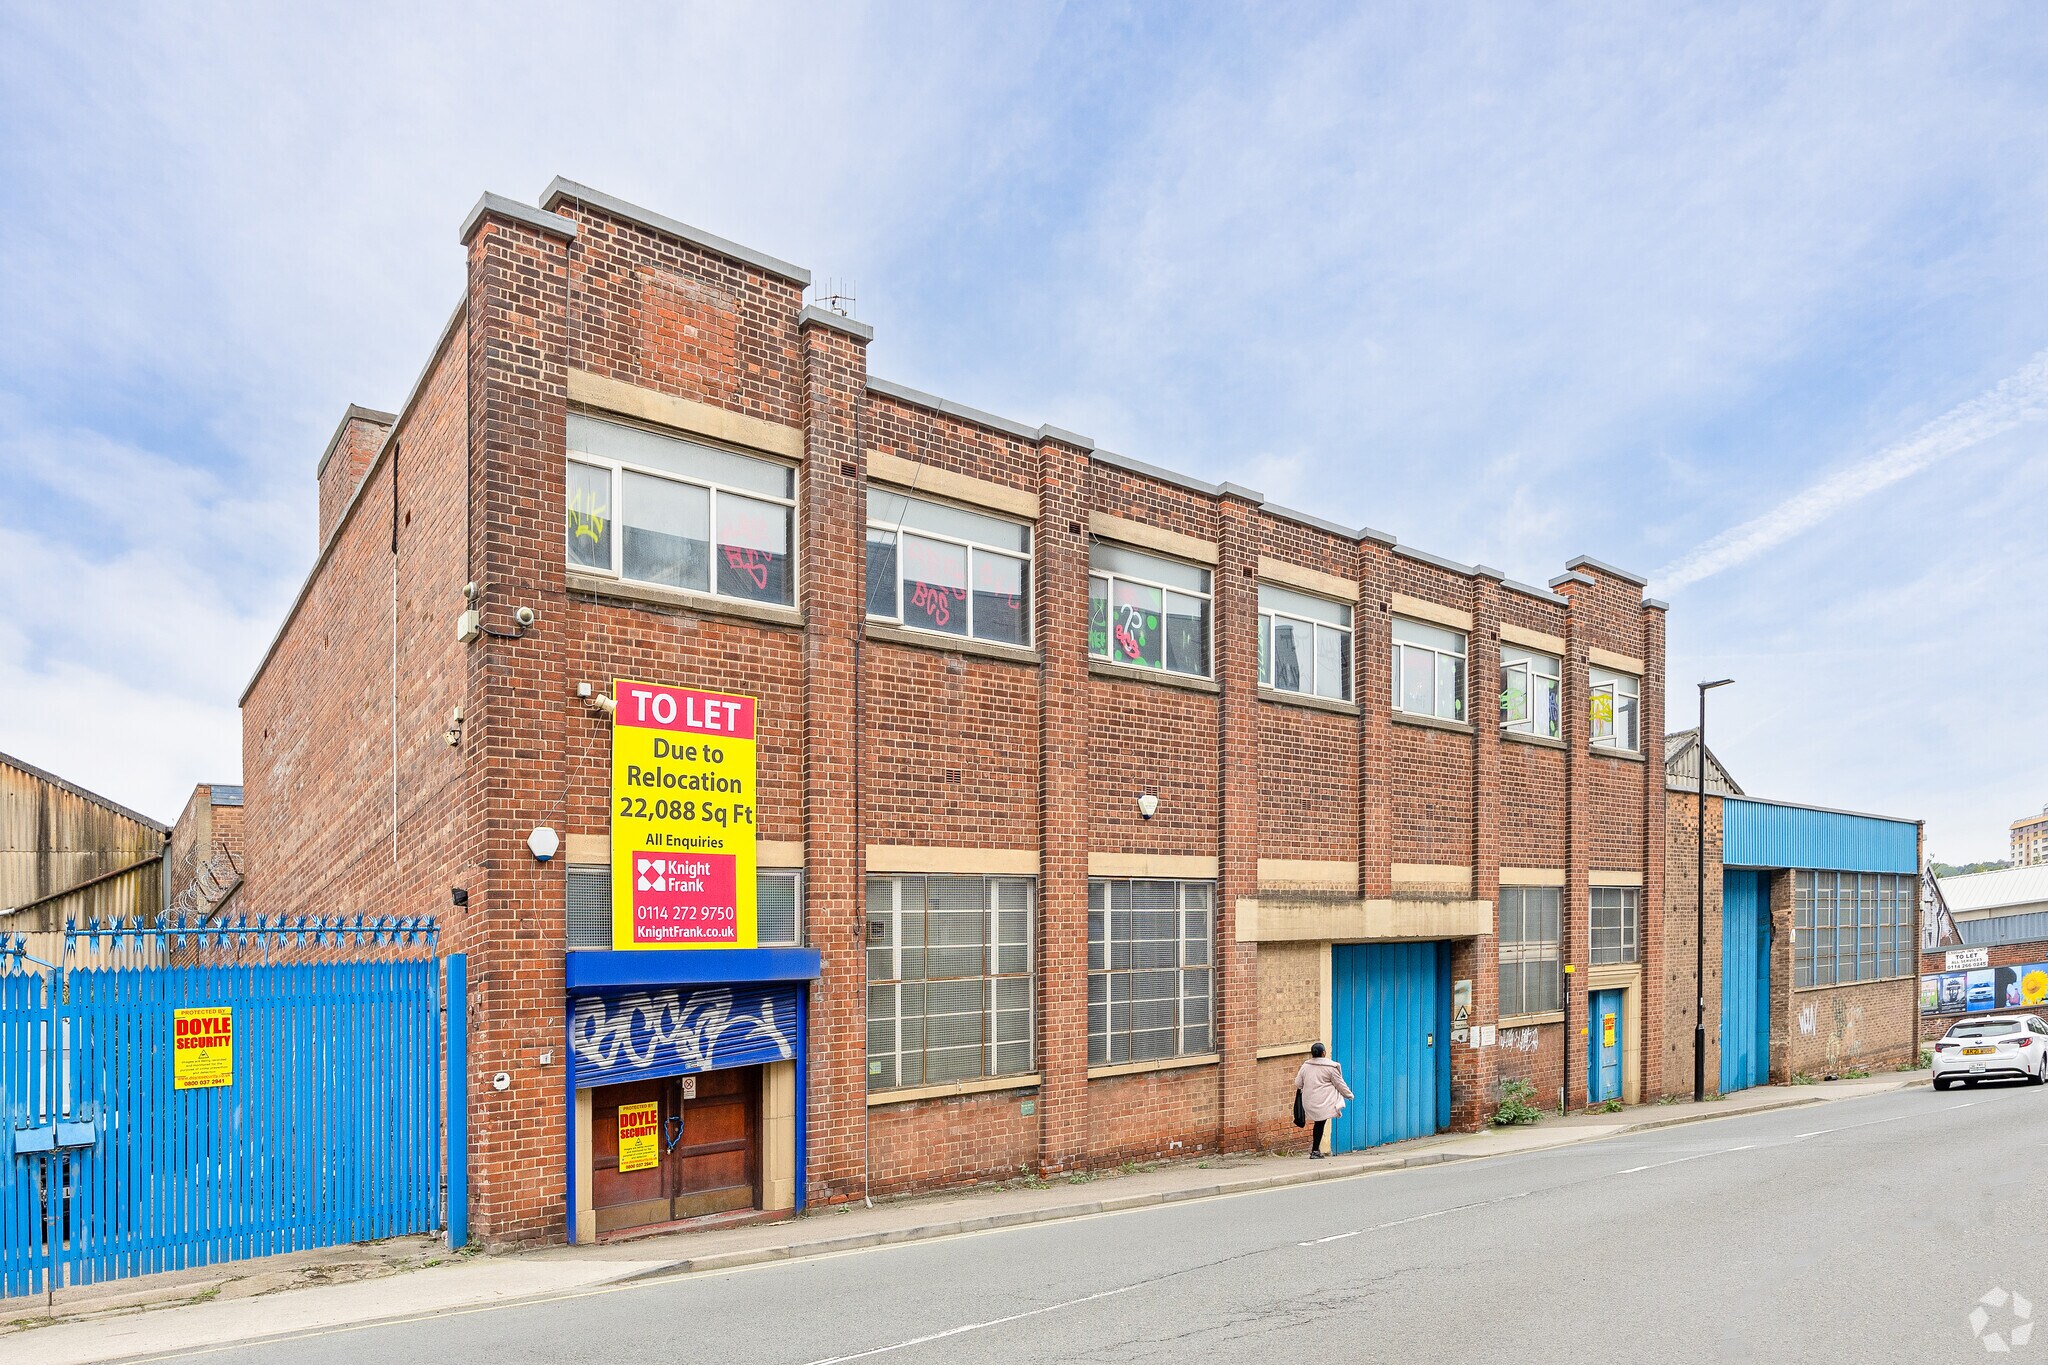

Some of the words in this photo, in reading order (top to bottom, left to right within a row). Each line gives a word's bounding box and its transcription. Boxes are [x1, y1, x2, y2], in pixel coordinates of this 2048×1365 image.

[632, 690, 677, 724] TO
[686, 697, 741, 732] LET
[654, 738, 697, 762] Due
[703, 744, 724, 764] to
[627, 765, 742, 794] Relocation
[620, 797, 695, 822] 22,088
[702, 802, 726, 828] Sq
[733, 804, 752, 824] Ft
[646, 834, 662, 846] All
[666, 835, 724, 850] Enquiries
[668, 860, 710, 878] Knight
[668, 877, 704, 892] Frank
[637, 905, 668, 920] 0114
[673, 906, 696, 920] 272
[700, 906, 734, 921] 9750
[637, 925, 734, 941] KnightFrank.co.uk
[176, 1017, 231, 1036] DOYLE
[176, 1035, 231, 1050] SECURITY
[620, 1110, 657, 1128] DOYLE
[620, 1125, 657, 1139] SECURITY
